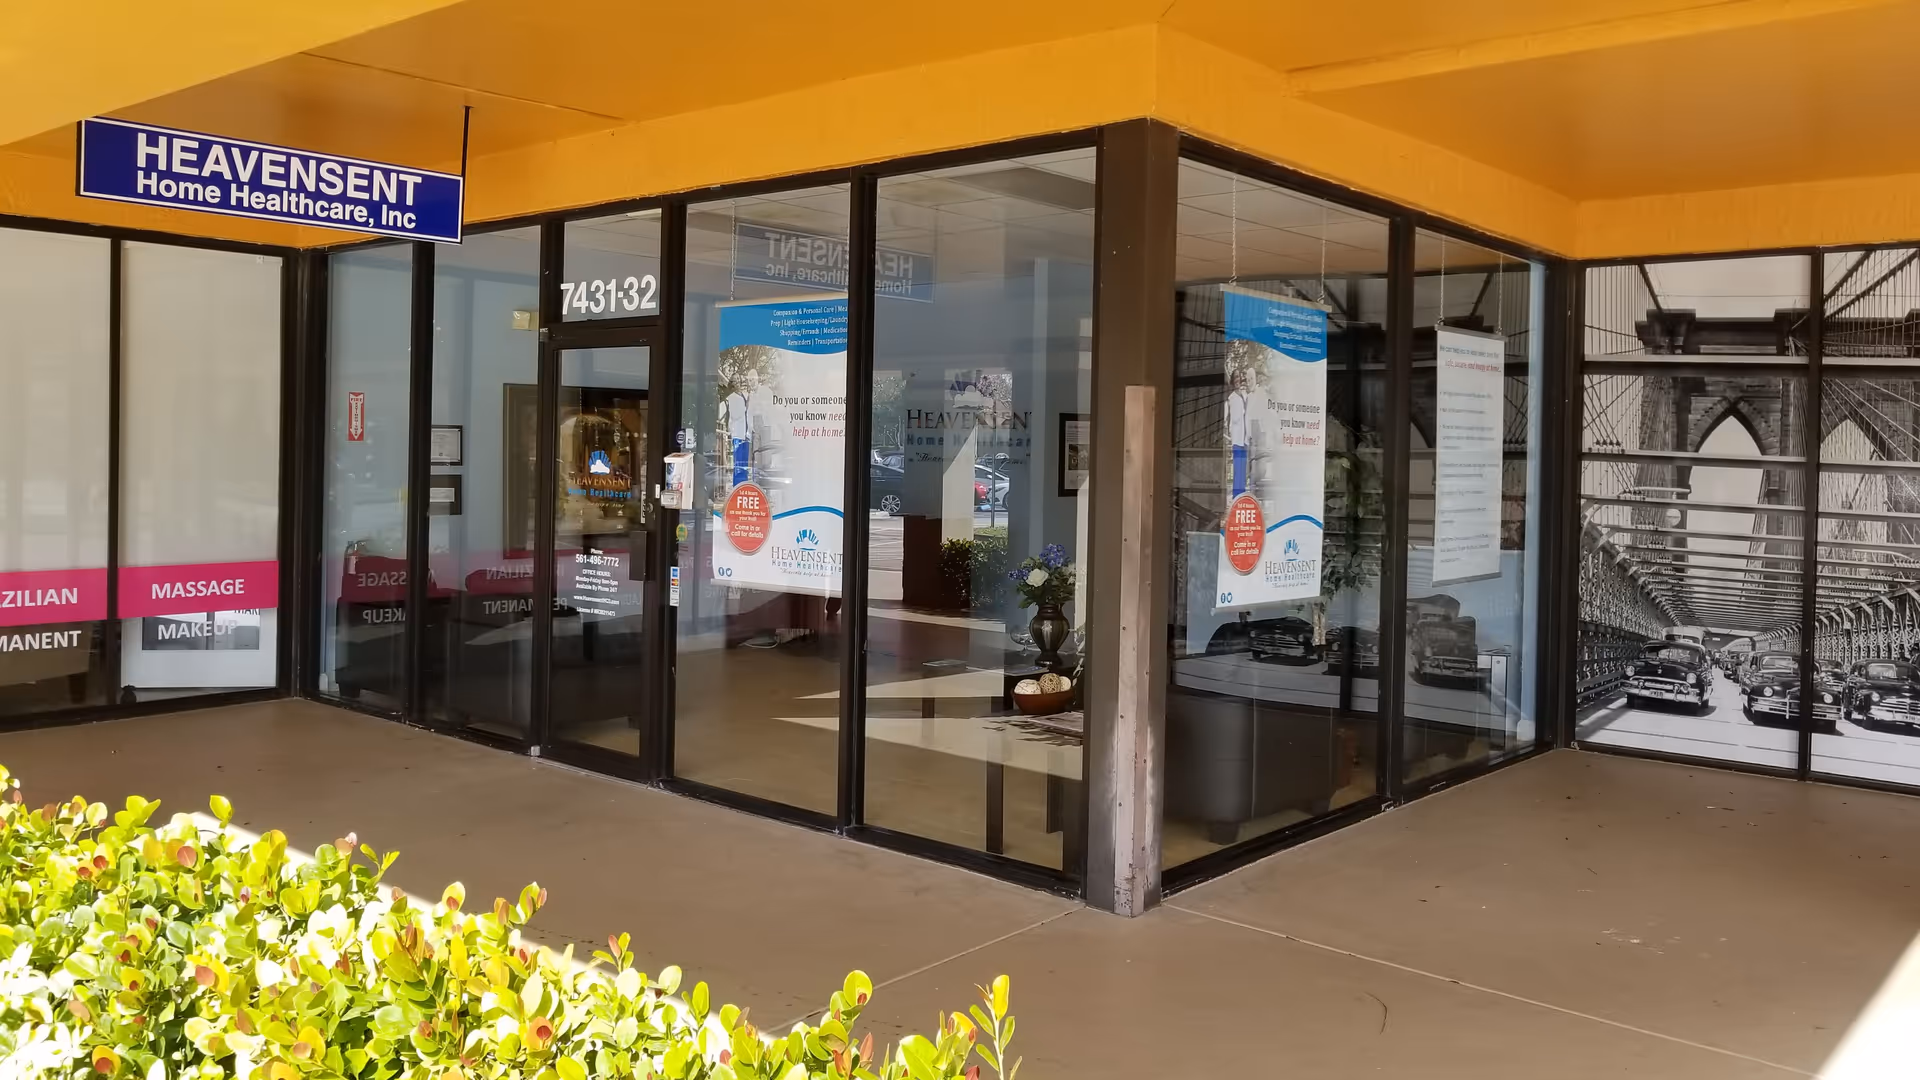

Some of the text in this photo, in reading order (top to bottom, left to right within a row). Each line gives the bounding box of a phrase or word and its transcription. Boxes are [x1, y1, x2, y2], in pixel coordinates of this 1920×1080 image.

[137, 132, 422, 206] HEAVENSENT
[136, 170, 417, 229] Home Healthcare, Inc
[560, 274, 657, 315] 7431-32
[803, 307, 823, 315] Personal
[823, 305, 835, 313] Care
[772, 395, 847, 408] Do you or someone
[1267, 398, 1320, 414] Do you or someone
[790, 412, 804, 424] you
[805, 410, 827, 421] know
[1280, 416, 1320, 430] you know need
[792, 426, 809, 440] help
[811, 429, 820, 437] at
[906, 433, 944, 447] Home
[1282, 432, 1294, 447] help
[736, 496, 760, 510] FREE
[1235, 510, 1256, 524] FREE
[734, 523, 749, 531] Come
[771, 546, 844, 565] HEAVENSENT
[1245, 547, 1260, 555] details
[575, 554, 620, 567] 561-496-7772
[1264, 559, 1317, 575] HEAVENSENT
[0, 578, 245, 608] ZILIAN MASSAGE
[157, 619, 238, 641] MAKEUP
